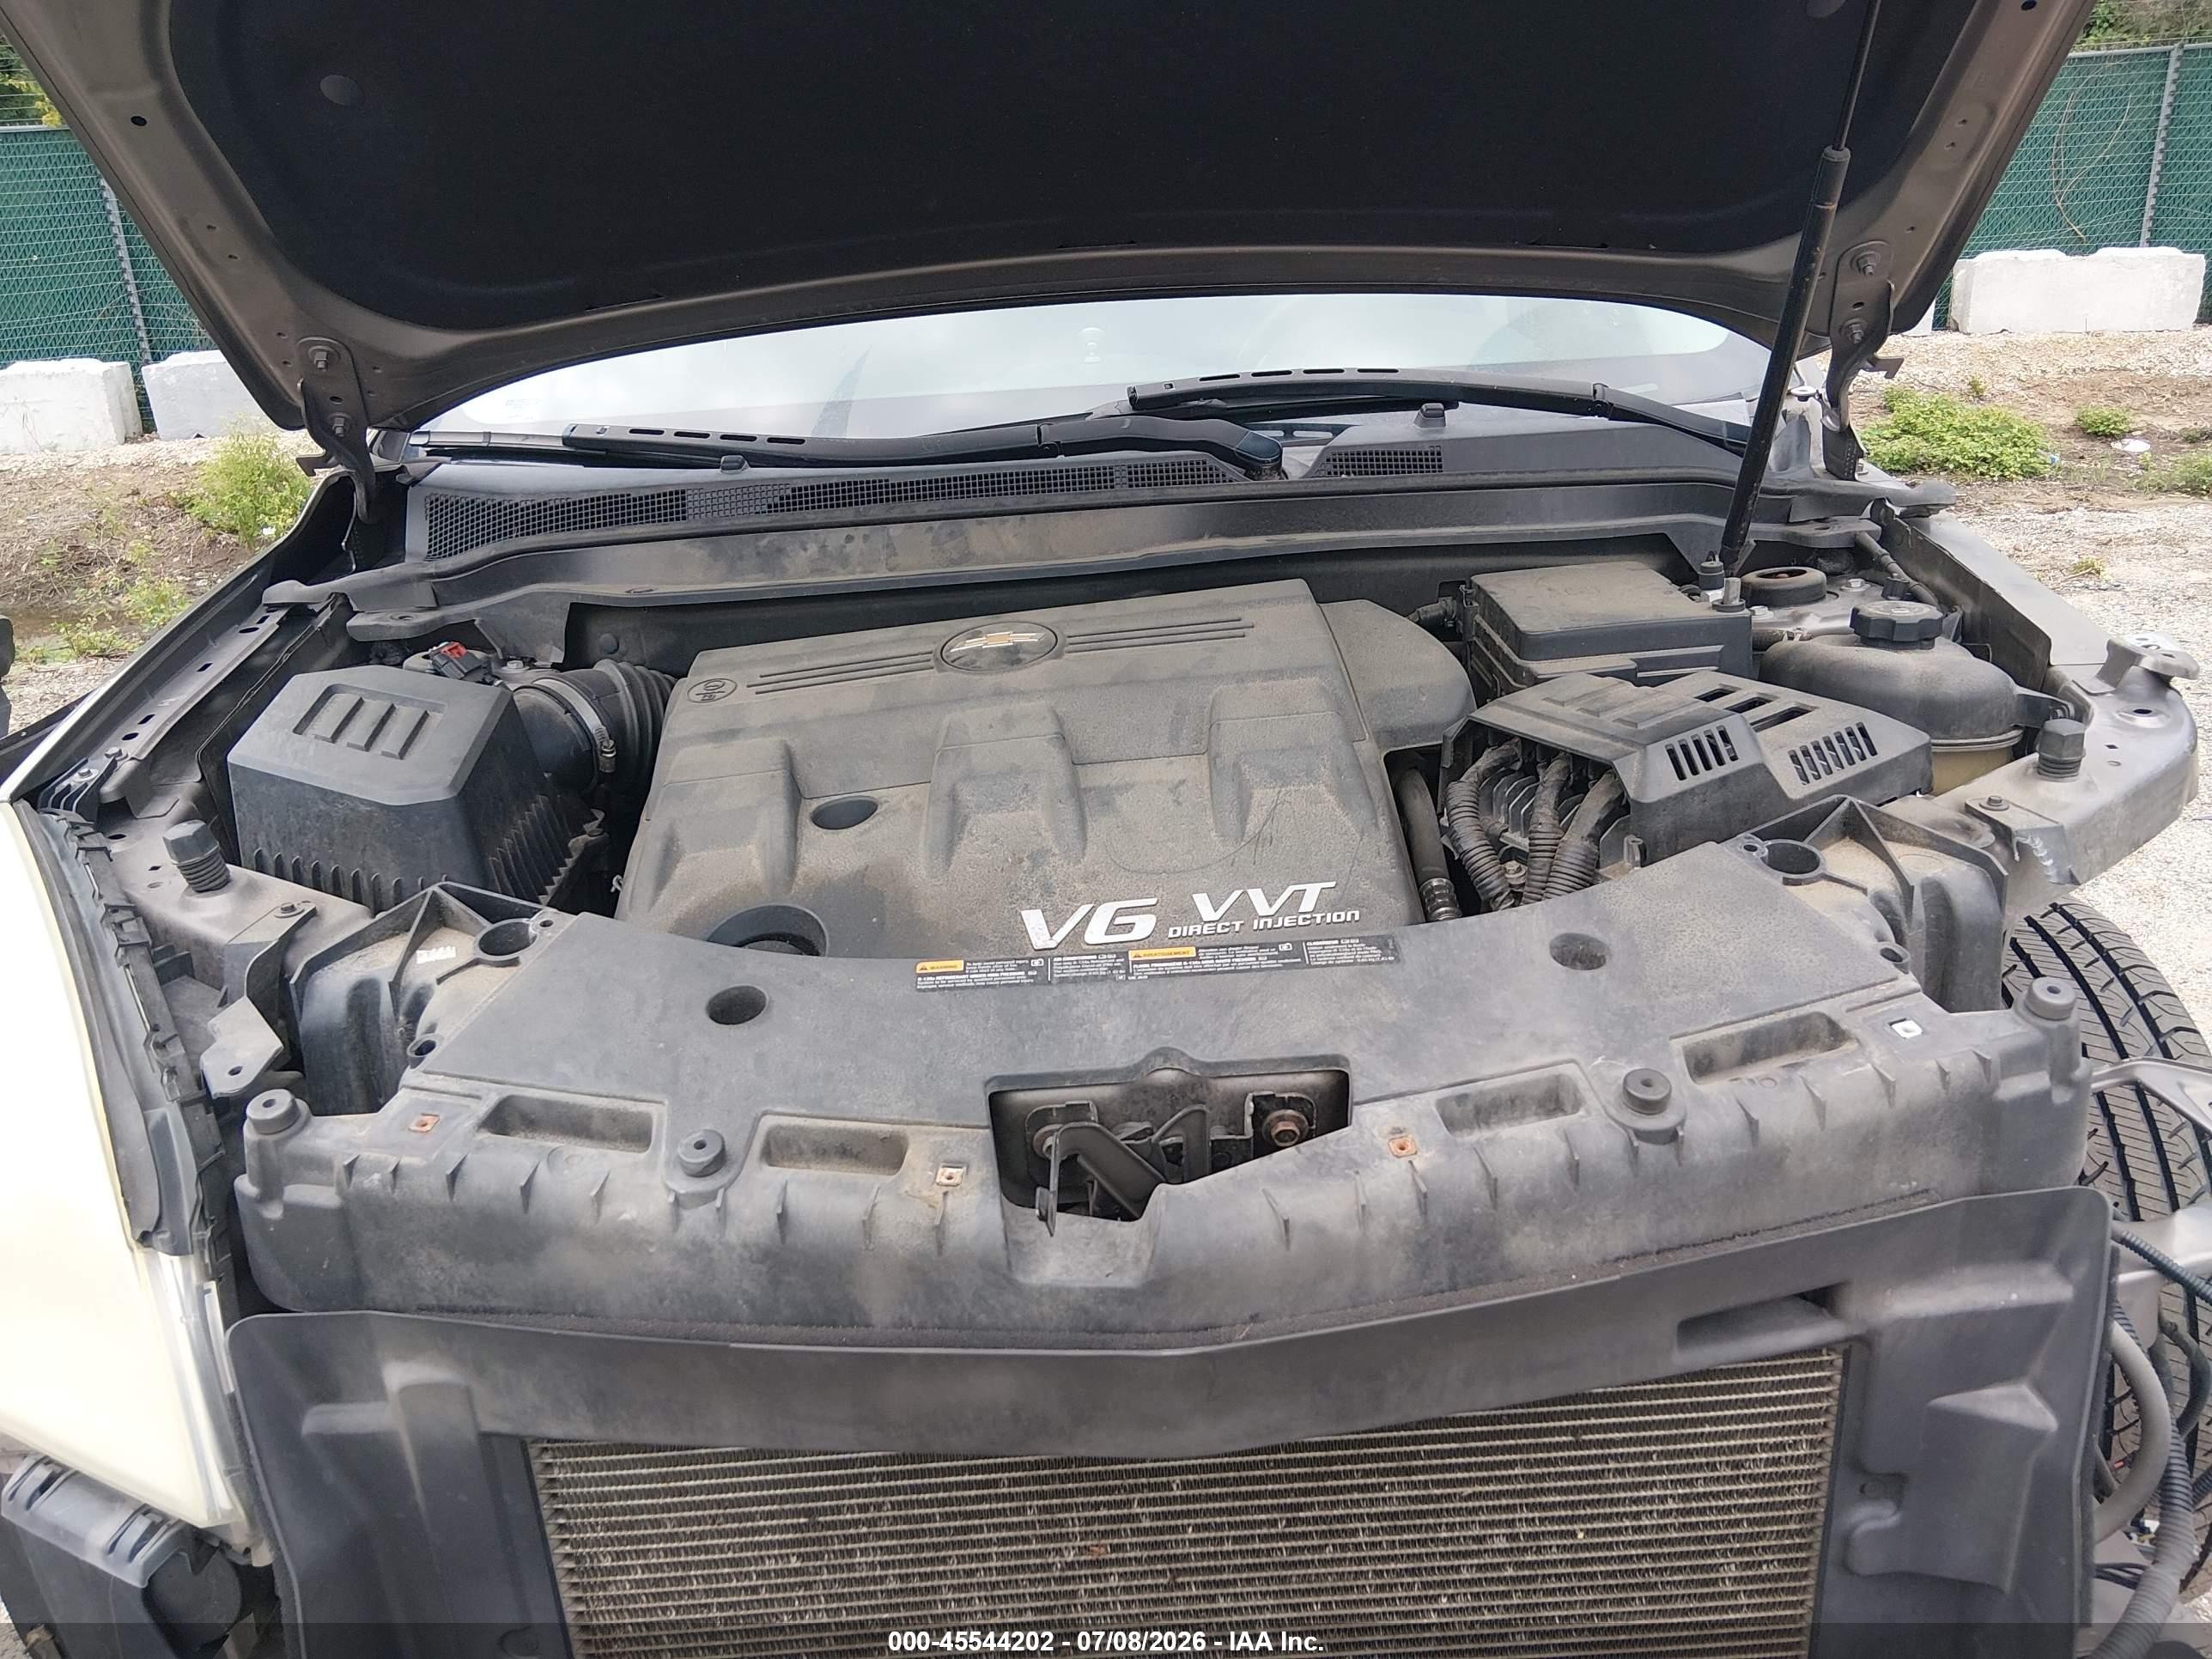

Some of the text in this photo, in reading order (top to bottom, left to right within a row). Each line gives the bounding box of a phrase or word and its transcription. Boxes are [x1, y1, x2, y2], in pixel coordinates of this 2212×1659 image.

[1020, 881, 1337, 951] V6 VVT
[1168, 909, 1360, 939] DIRECT INJECTION
